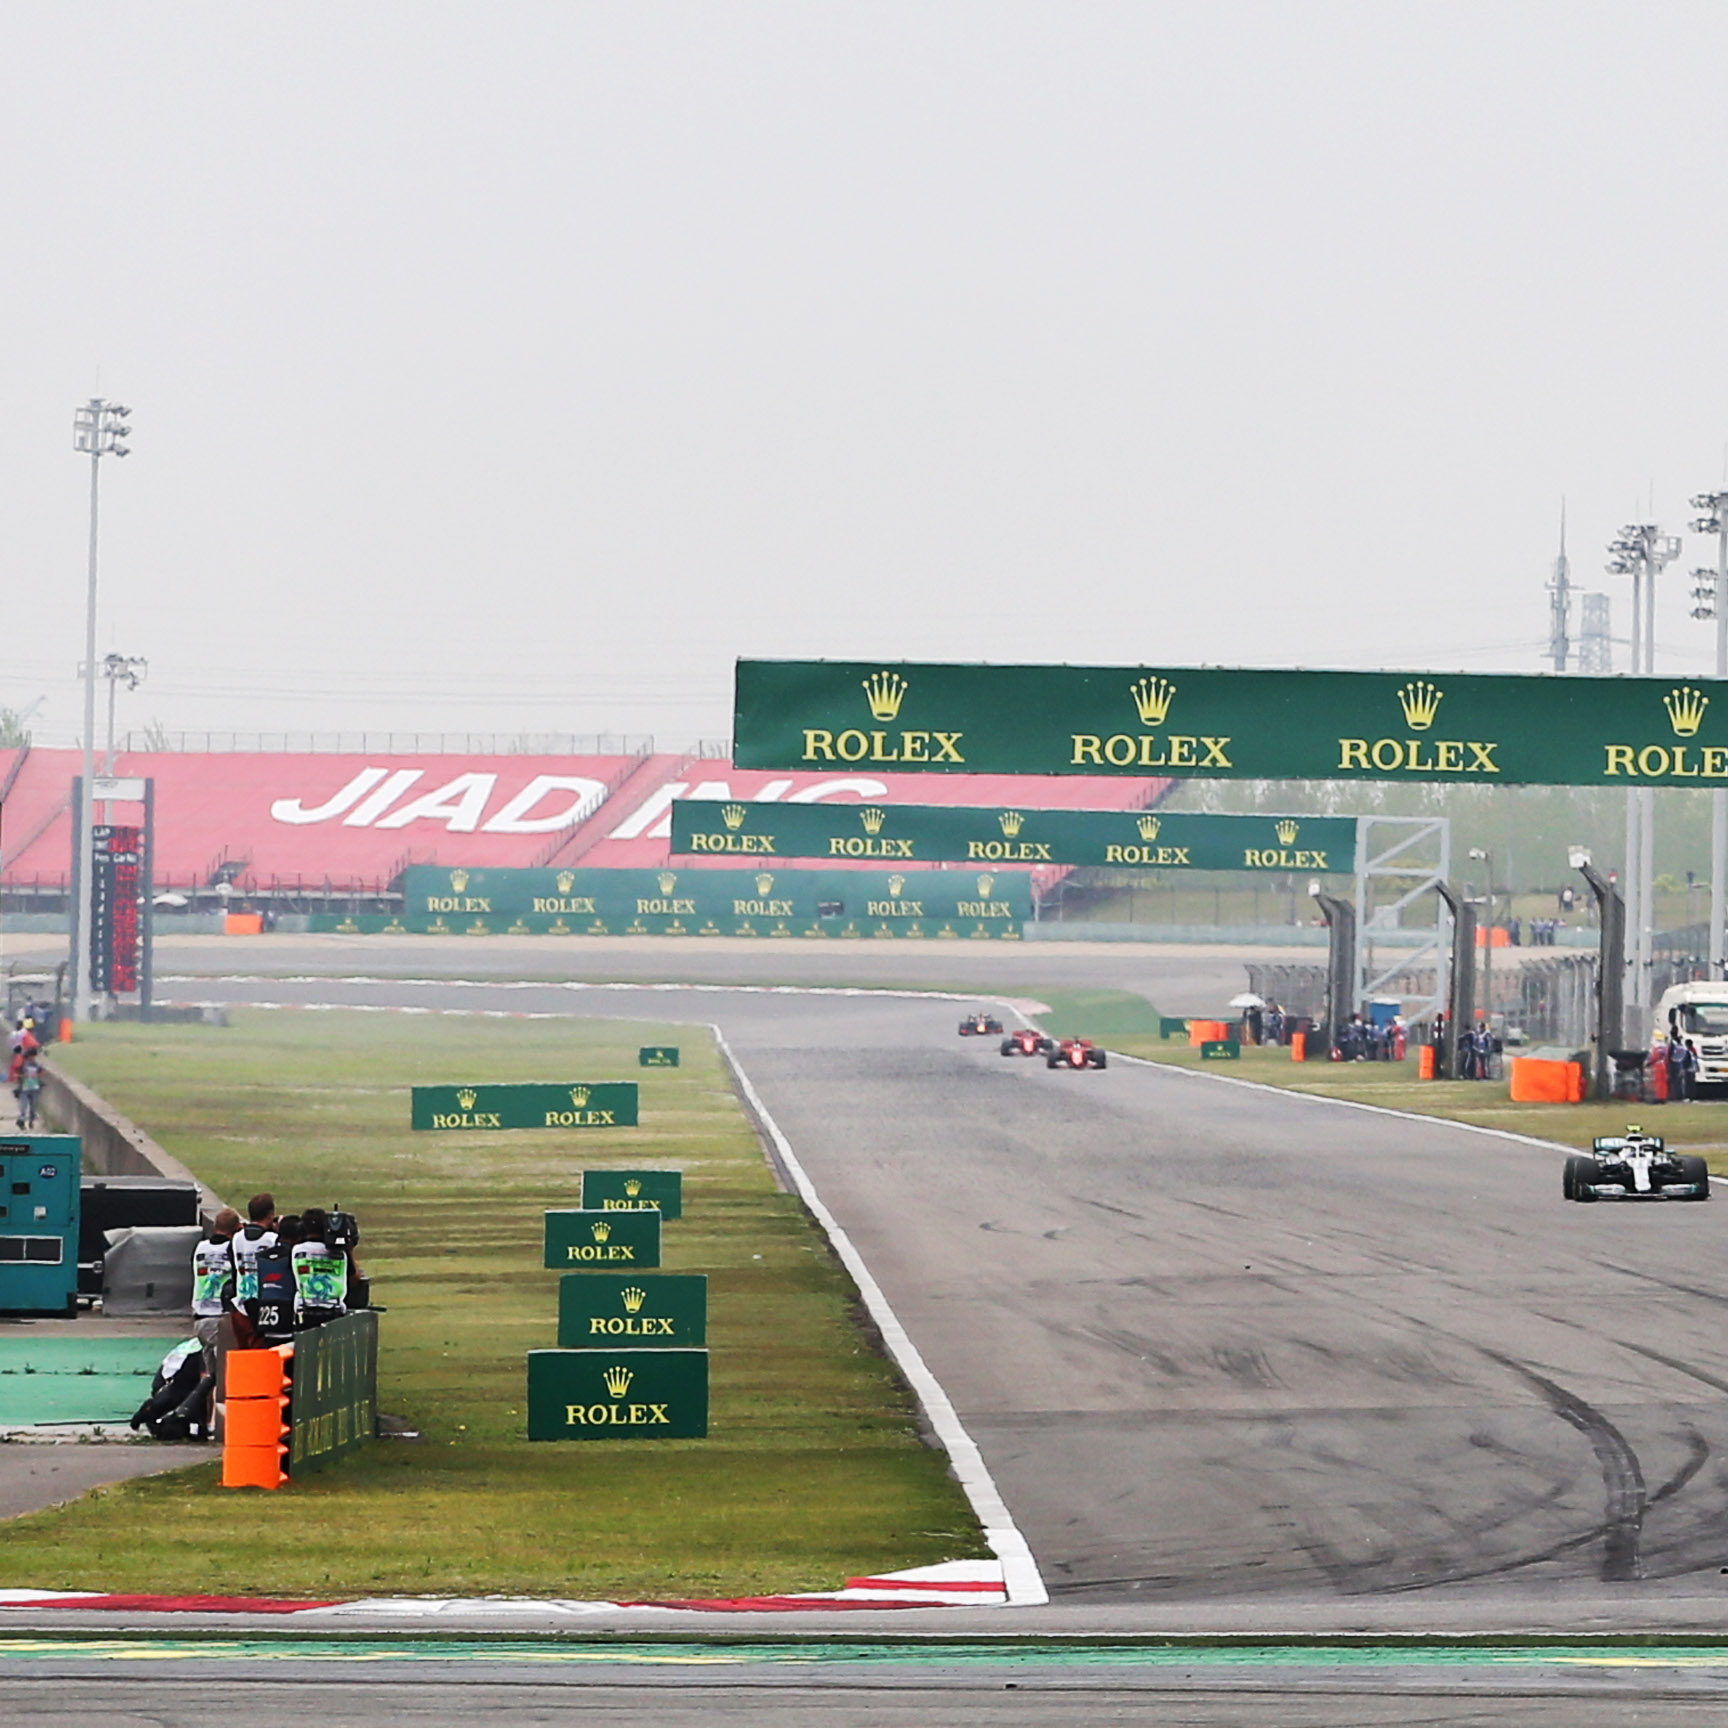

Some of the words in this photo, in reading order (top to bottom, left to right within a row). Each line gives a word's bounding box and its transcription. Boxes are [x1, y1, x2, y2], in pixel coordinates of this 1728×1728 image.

[801, 729, 965, 763] ROLEX
[1070, 734, 1232, 767] ROLEX
[1337, 738, 1500, 773] ROLEX
[690, 833, 777, 855] ROLEX
[828, 836, 914, 859] ROLEX
[966, 839, 1052, 862] ROLEX
[1106, 845, 1190, 865] ROLEX
[1244, 849, 1328, 869] ROLEX
[427, 896, 491, 912] ROLEX
[533, 897, 595, 913] ROLEX
[636, 898, 695, 914] ROLEX
[733, 899, 793, 916] ROLEX
[867, 900, 923, 916] ROLEX
[957, 901, 1012, 918] ROLEX
[433, 1113, 501, 1129] ROLEX
[544, 1109, 616, 1128] ROLEX
[603, 1199, 660, 1210] ROLEX
[567, 1245, 634, 1261] ROLEX
[590, 1317, 674, 1335] ROLEX
[566, 1403, 670, 1425] ROLEX
